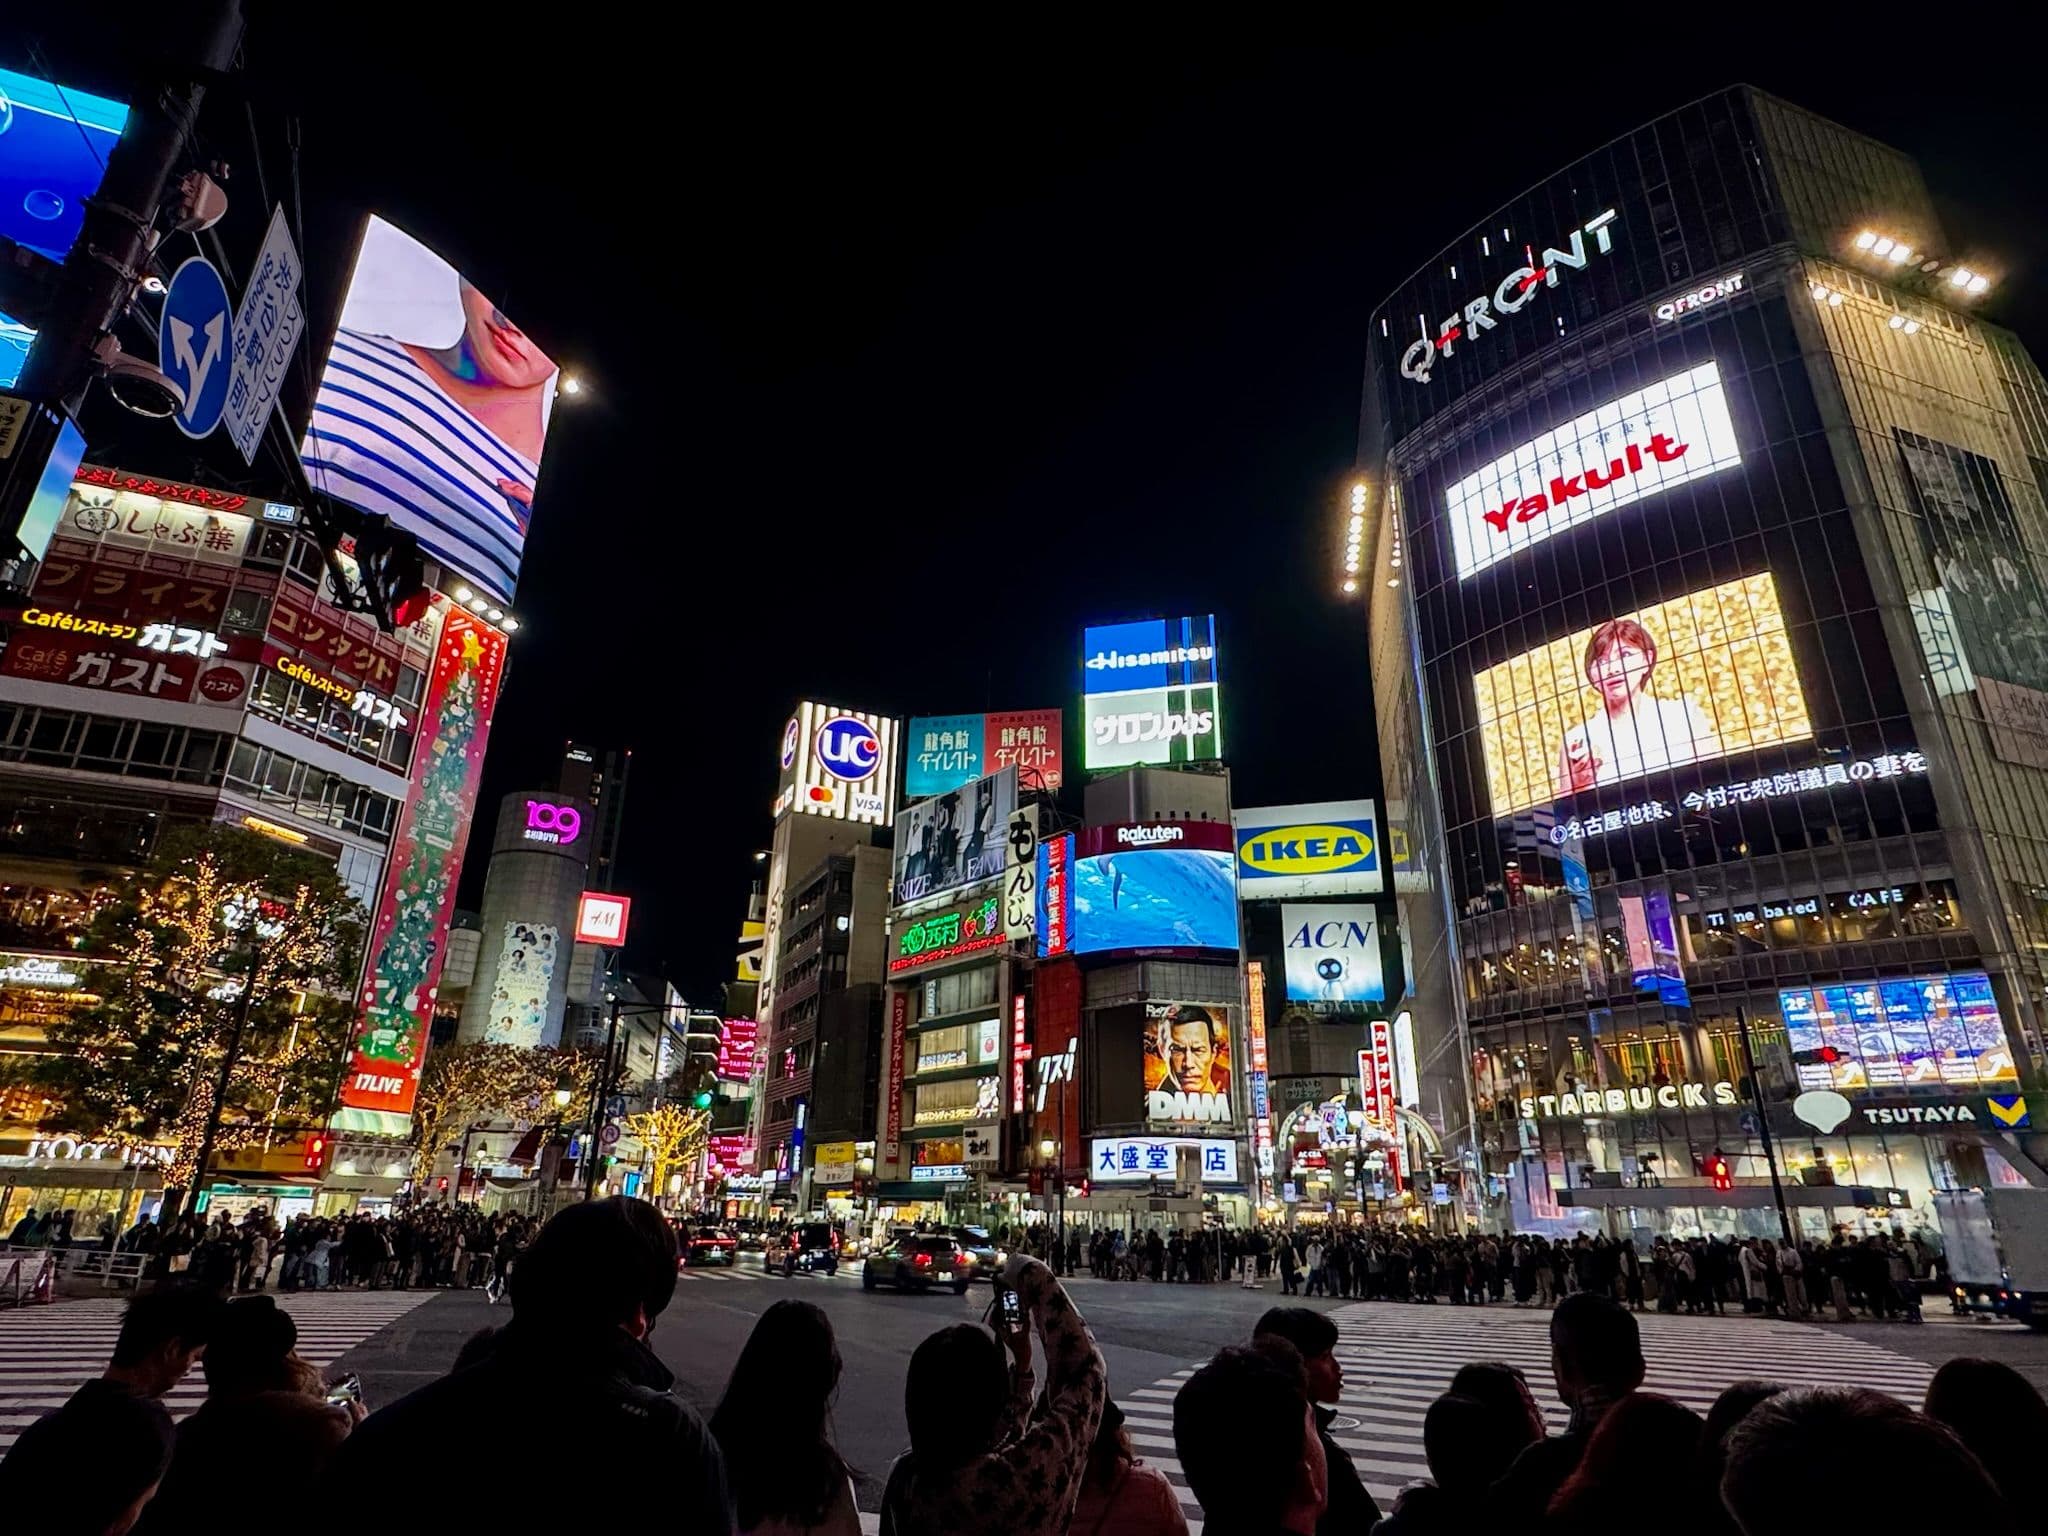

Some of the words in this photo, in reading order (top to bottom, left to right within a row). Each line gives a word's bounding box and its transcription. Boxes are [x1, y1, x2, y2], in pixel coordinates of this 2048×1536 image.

[244, 253, 274, 326] Shibuya
[1400, 208, 1616, 384] QFRONT
[1656, 275, 1744, 321] QFRONT
[229, 252, 291, 420] 渋谷駅前
[75, 467, 247, 509] ゃぶしゃぶバイキング
[1483, 432, 1689, 533] Yakult
[124, 510, 236, 551] しゃぶ葉
[42, 562, 217, 613] プライス
[137, 624, 228, 658] ガスト
[271, 603, 394, 681] コンタクト
[68, 652, 182, 694] ガスト
[1086, 646, 1213, 669] Hisamitsu
[204, 680, 239, 693] ガスト
[351, 689, 408, 729] ガスト
[924, 731, 969, 752] 龍角散
[1001, 726, 1047, 746] 龍角散
[917, 752, 977, 772] ダイレクト
[994, 747, 1056, 769] ダイレクト
[1682, 751, 1928, 812] 今村元衆院議員の妻を
[856, 798, 882, 812] VISA
[524, 829, 559, 843] SHIBUYA
[527, 801, 580, 843] 109
[1117, 825, 1183, 843] Rakuten
[1252, 836, 1364, 862] IKEA
[1007, 812, 1035, 932] もんじゃ
[1763, 901, 1817, 919] baed
[1849, 889, 1903, 908] CAFE
[1288, 921, 1374, 949] ACN
[1786, 997, 1806, 1010] 2F
[1852, 991, 1875, 1005] 3F
[1924, 985, 1946, 999] 4F
[1376, 1031, 1389, 1091] カラオケ
[354, 1073, 404, 1095] 17LIVE
[1149, 1090, 1231, 1122] DMM
[1521, 1082, 1737, 1118] STARBUCKS
[1863, 1105, 1976, 1124] TSUTAYA
[1100, 1146, 1226, 1171] 大盛堂店
